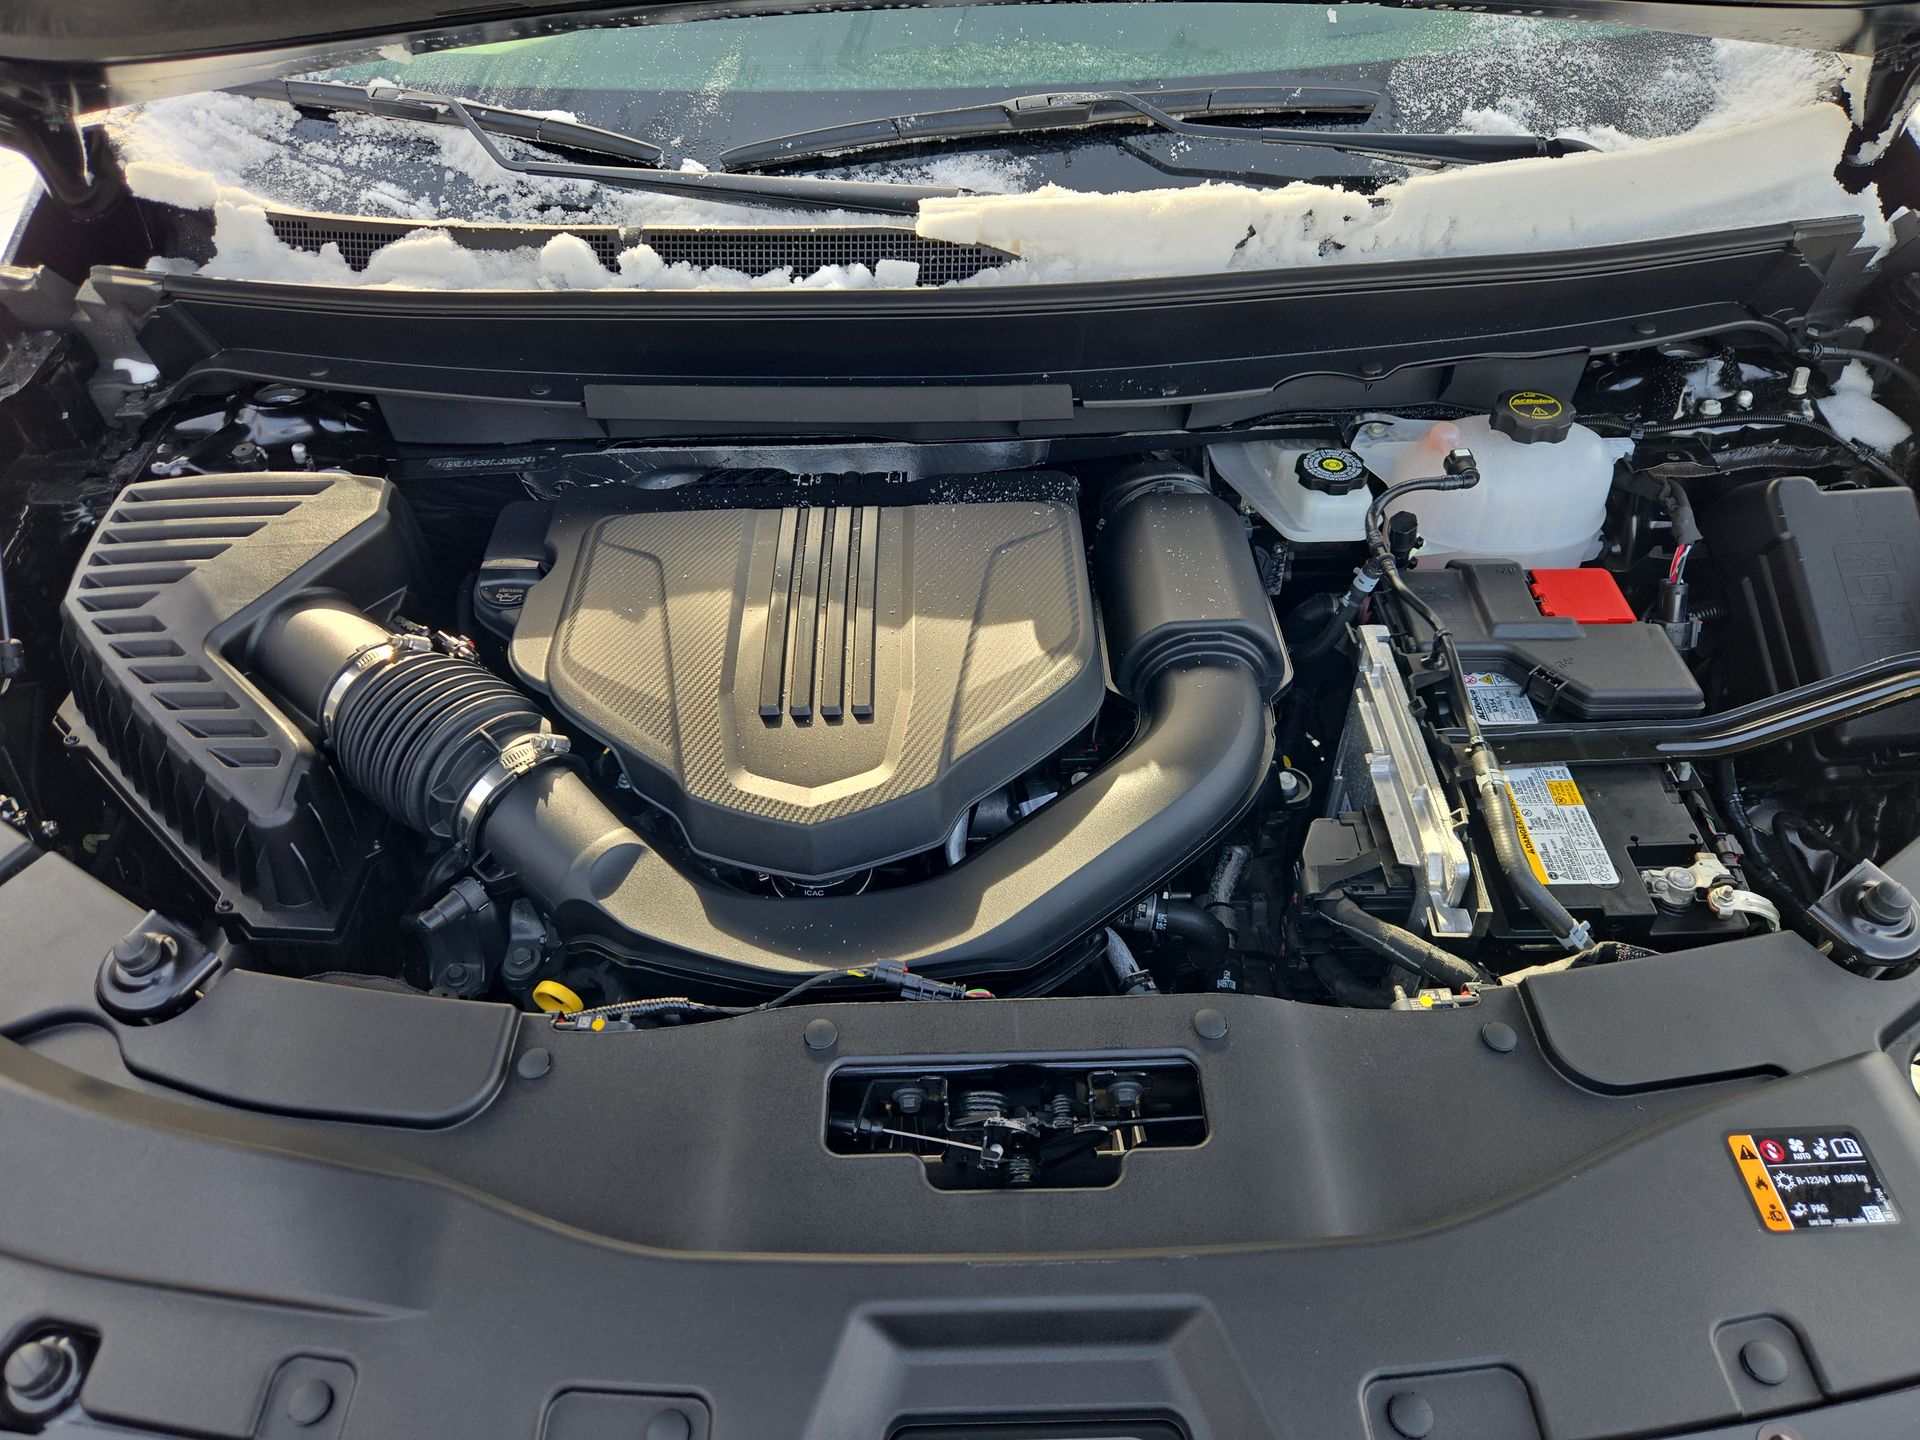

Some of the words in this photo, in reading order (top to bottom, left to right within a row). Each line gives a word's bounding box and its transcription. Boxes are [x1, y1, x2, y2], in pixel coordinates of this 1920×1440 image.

[1793, 1152, 1812, 1161] AUTO
[1856, 1173, 1869, 1184] kg
[1810, 1203, 1829, 1214] PAG
